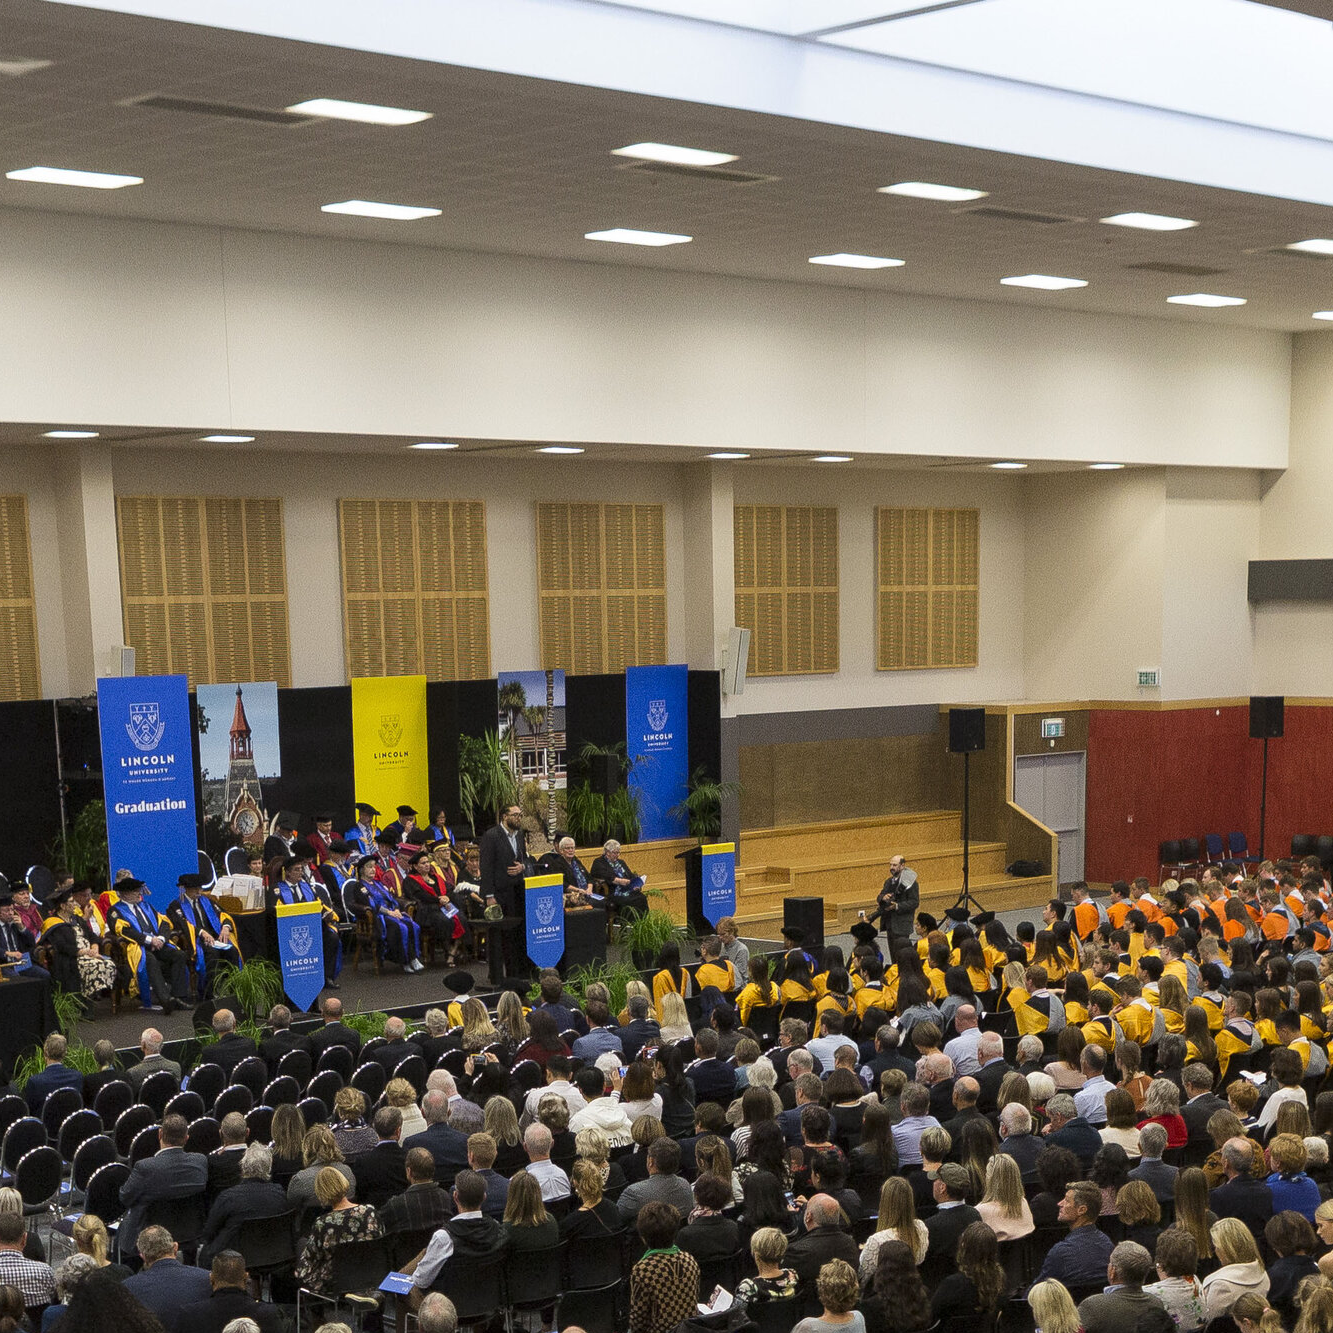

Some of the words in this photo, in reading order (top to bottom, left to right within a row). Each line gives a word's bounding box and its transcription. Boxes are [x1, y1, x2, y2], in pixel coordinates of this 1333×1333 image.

[643, 733, 673, 741] LINCOLN
[373, 751, 409, 759] LINCOLN
[121, 754, 175, 767] LINCOLN
[129, 768, 169, 776] UNIVERSITY
[115, 798, 187, 814] Graduation
[532, 926, 561, 934] LINCOLN
[285, 957, 319, 967] LINCOLN
